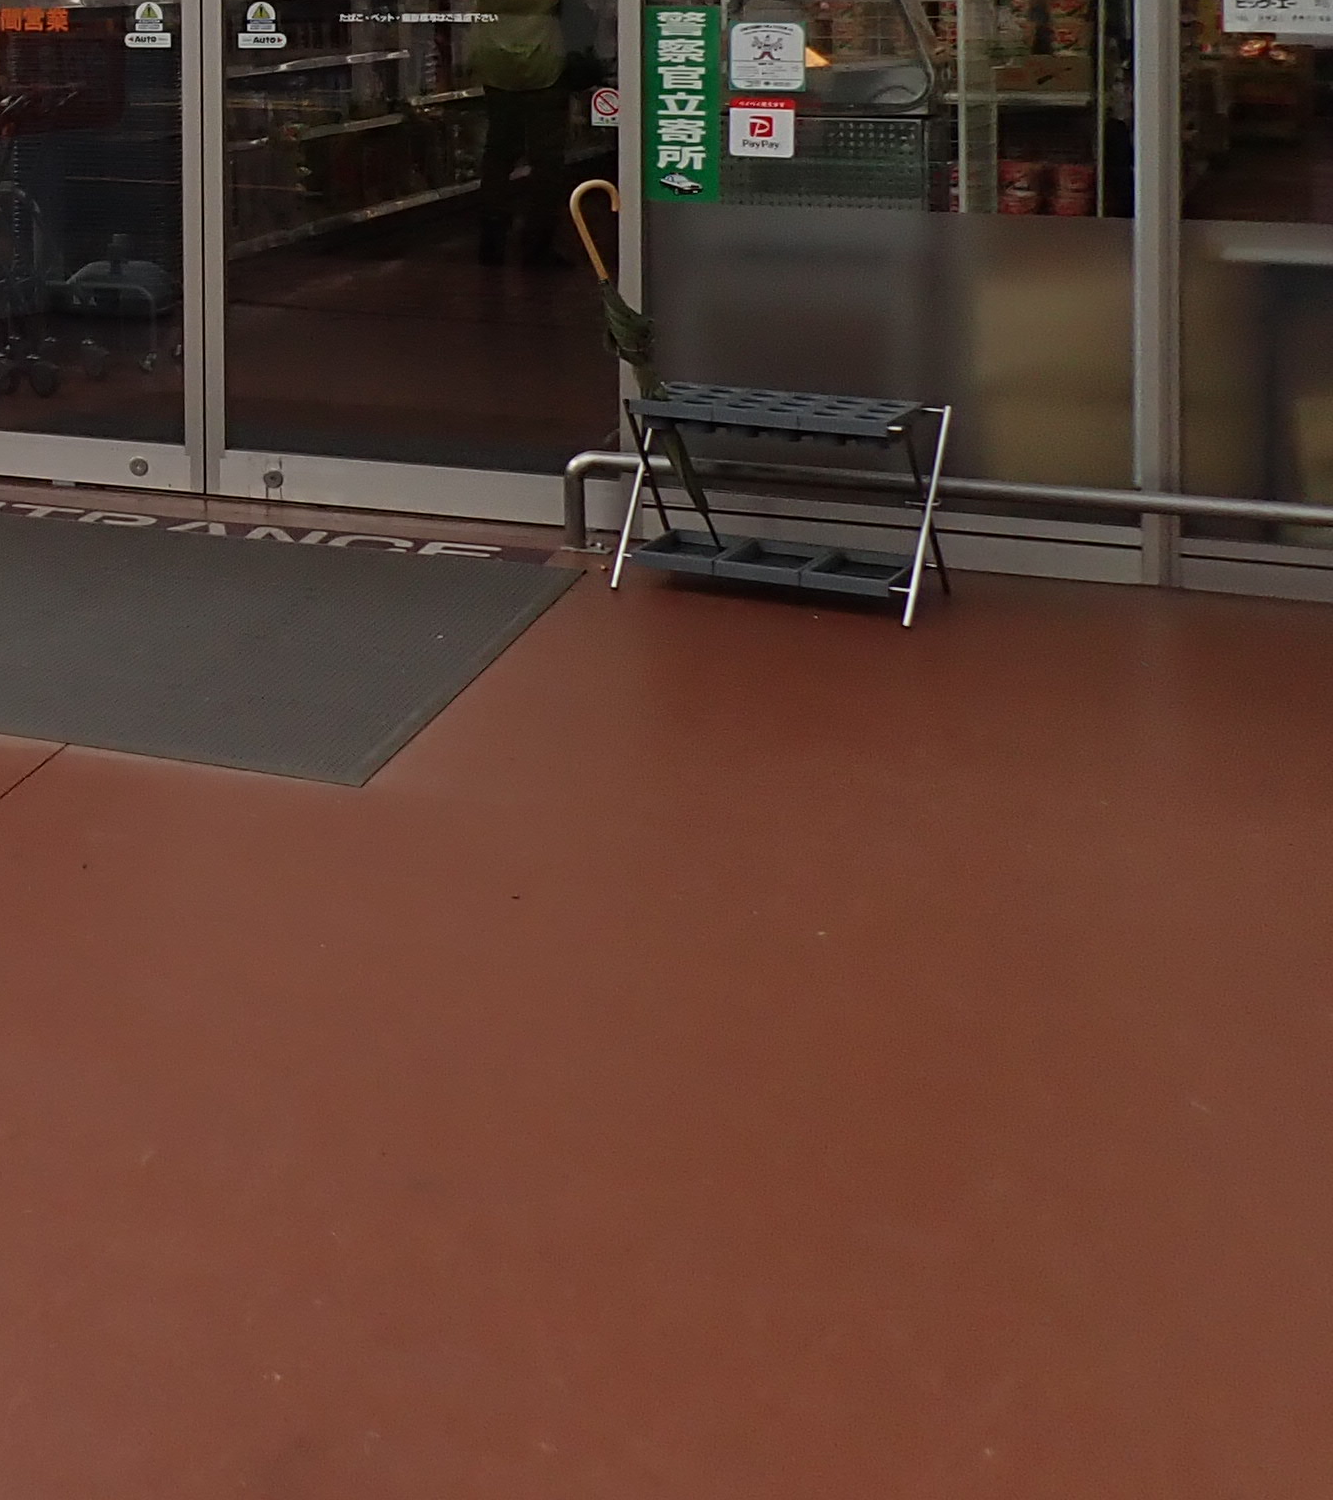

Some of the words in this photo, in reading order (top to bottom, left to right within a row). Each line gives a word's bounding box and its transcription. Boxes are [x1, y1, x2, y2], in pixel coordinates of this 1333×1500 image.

[656, 11, 706, 170] 警察官立寄所
[742, 139, 779, 149] PayPay
